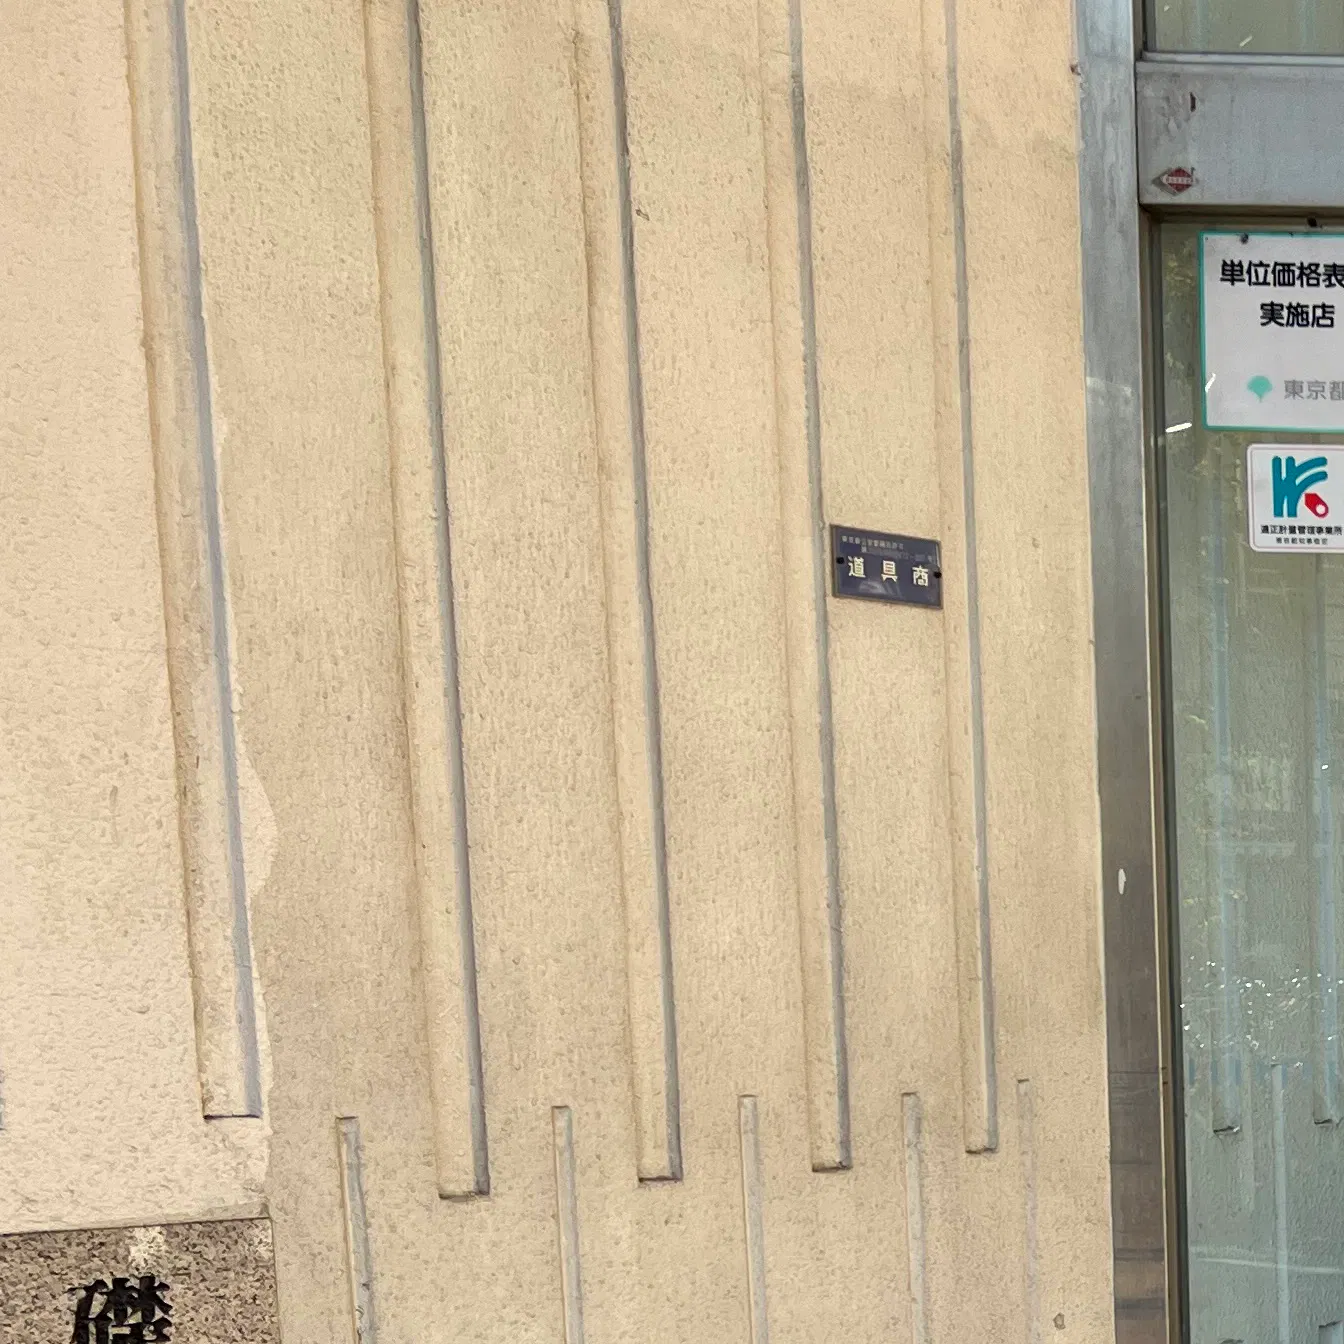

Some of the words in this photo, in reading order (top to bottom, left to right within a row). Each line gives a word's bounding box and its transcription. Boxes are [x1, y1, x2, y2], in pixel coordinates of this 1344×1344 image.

[1259, 302, 1336, 329] 実施店
[847, 555, 929, 587] 道具商
